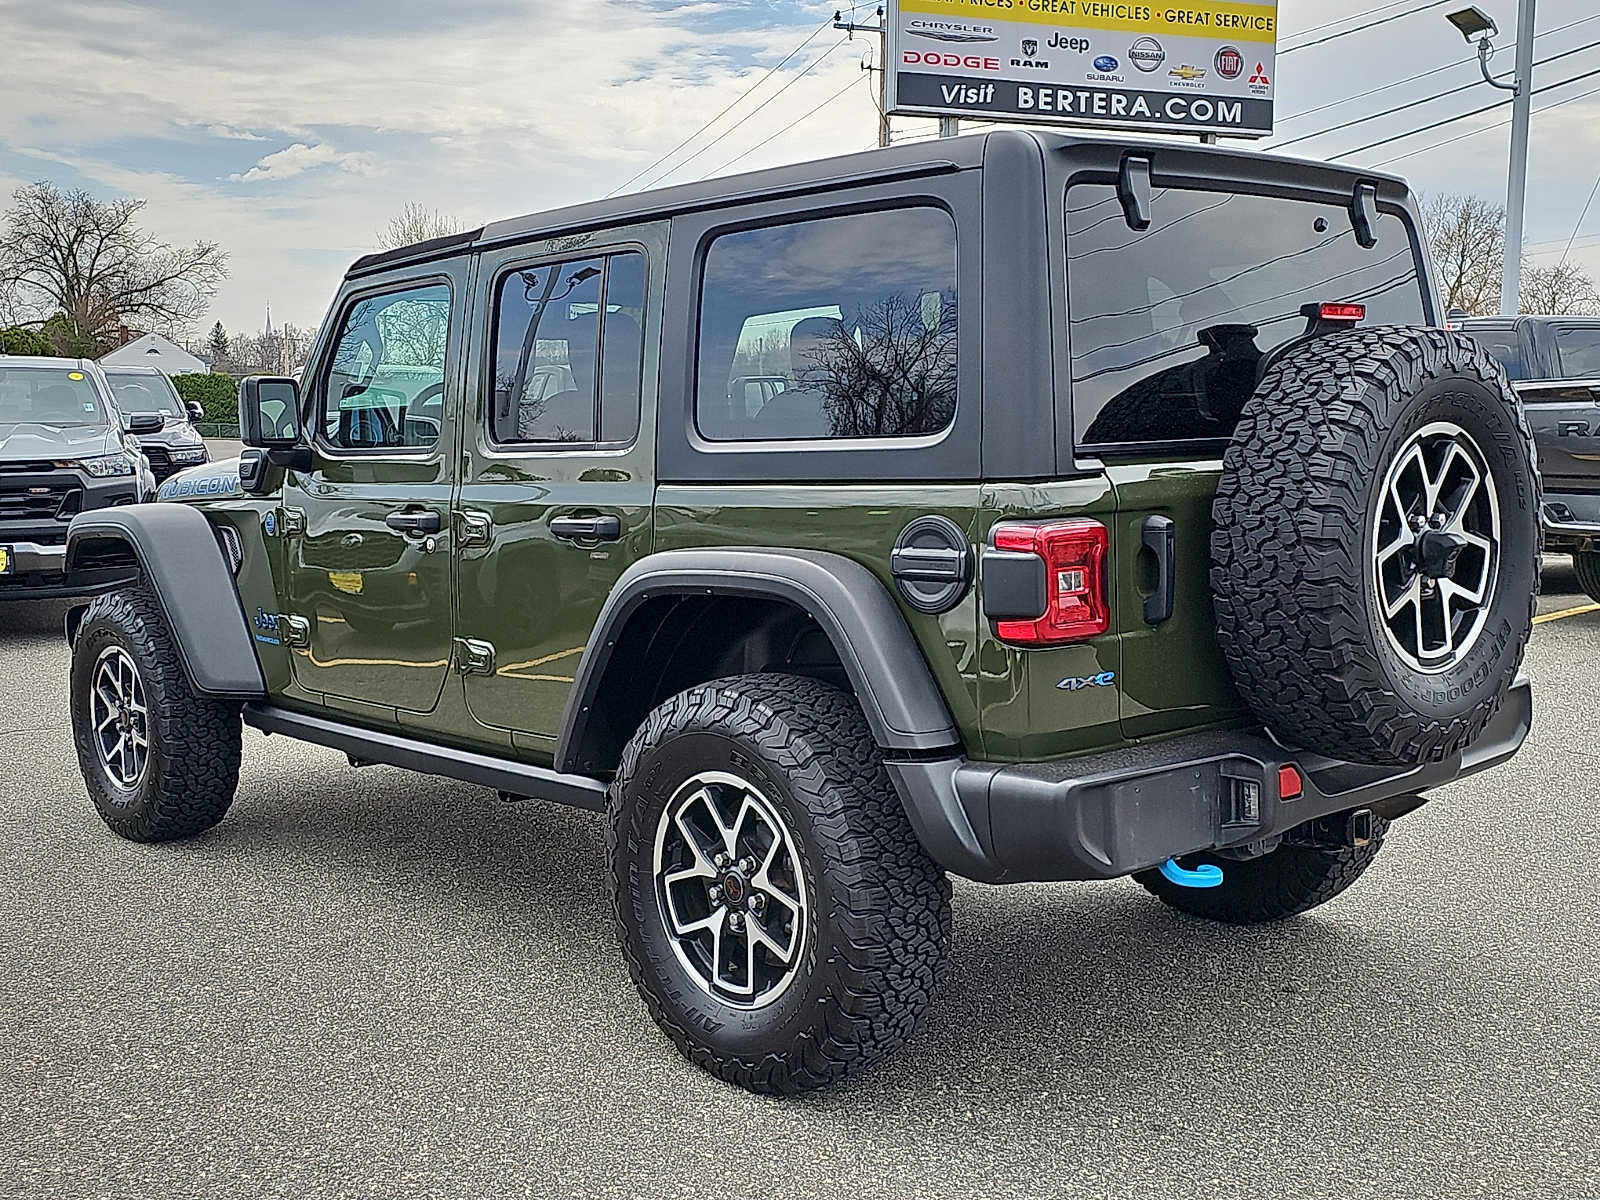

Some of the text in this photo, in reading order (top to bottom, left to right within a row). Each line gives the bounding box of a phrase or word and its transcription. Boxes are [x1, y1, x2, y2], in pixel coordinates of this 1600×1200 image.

[1028, 0, 1076, 14] GREAT
[1081, 3, 1150, 20] VEHICLES
[1164, 9, 1211, 25] GREAT
[1215, 13, 1273, 30] SERVICE
[911, 20, 994, 33] CHRYSLER
[1047, 31, 1089, 54] Jeep
[903, 51, 1000, 70] DODGE
[1010, 59, 1049, 68] RAM
[1131, 51, 1163, 60] NISSAN
[1221, 55, 1238, 71] FIAT
[1086, 73, 1125, 82] SUBARU
[1169, 81, 1206, 89] CHEVROLET
[940, 83, 1242, 123] Visit BERTERA.COM
[159, 475, 240, 499] RUBICON
